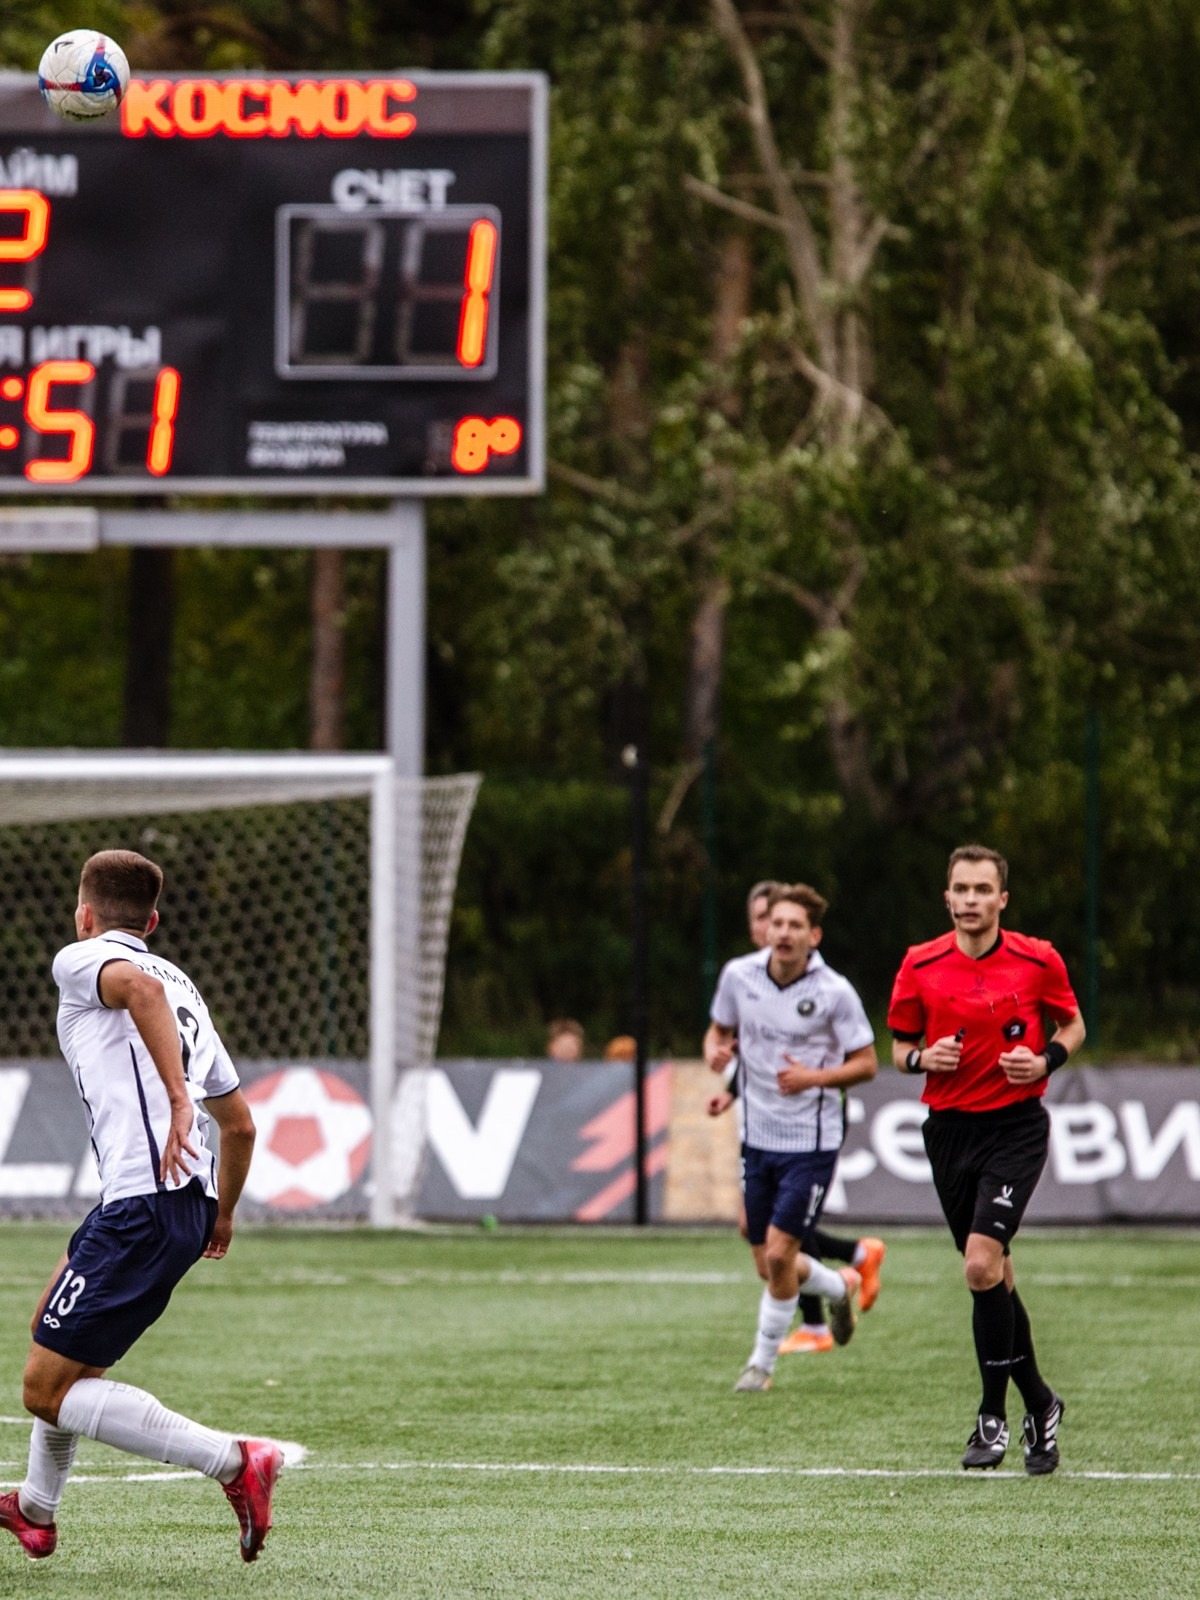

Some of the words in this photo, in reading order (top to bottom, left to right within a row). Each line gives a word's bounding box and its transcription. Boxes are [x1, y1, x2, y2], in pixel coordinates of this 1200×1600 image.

[120, 78, 417, 138] КОСМОС
[331, 168, 455, 210] СЧЕТ
[455, 218, 498, 368] 1
[30, 325, 161, 368] ИГРЫ
[47, 1268, 86, 1317] 13
